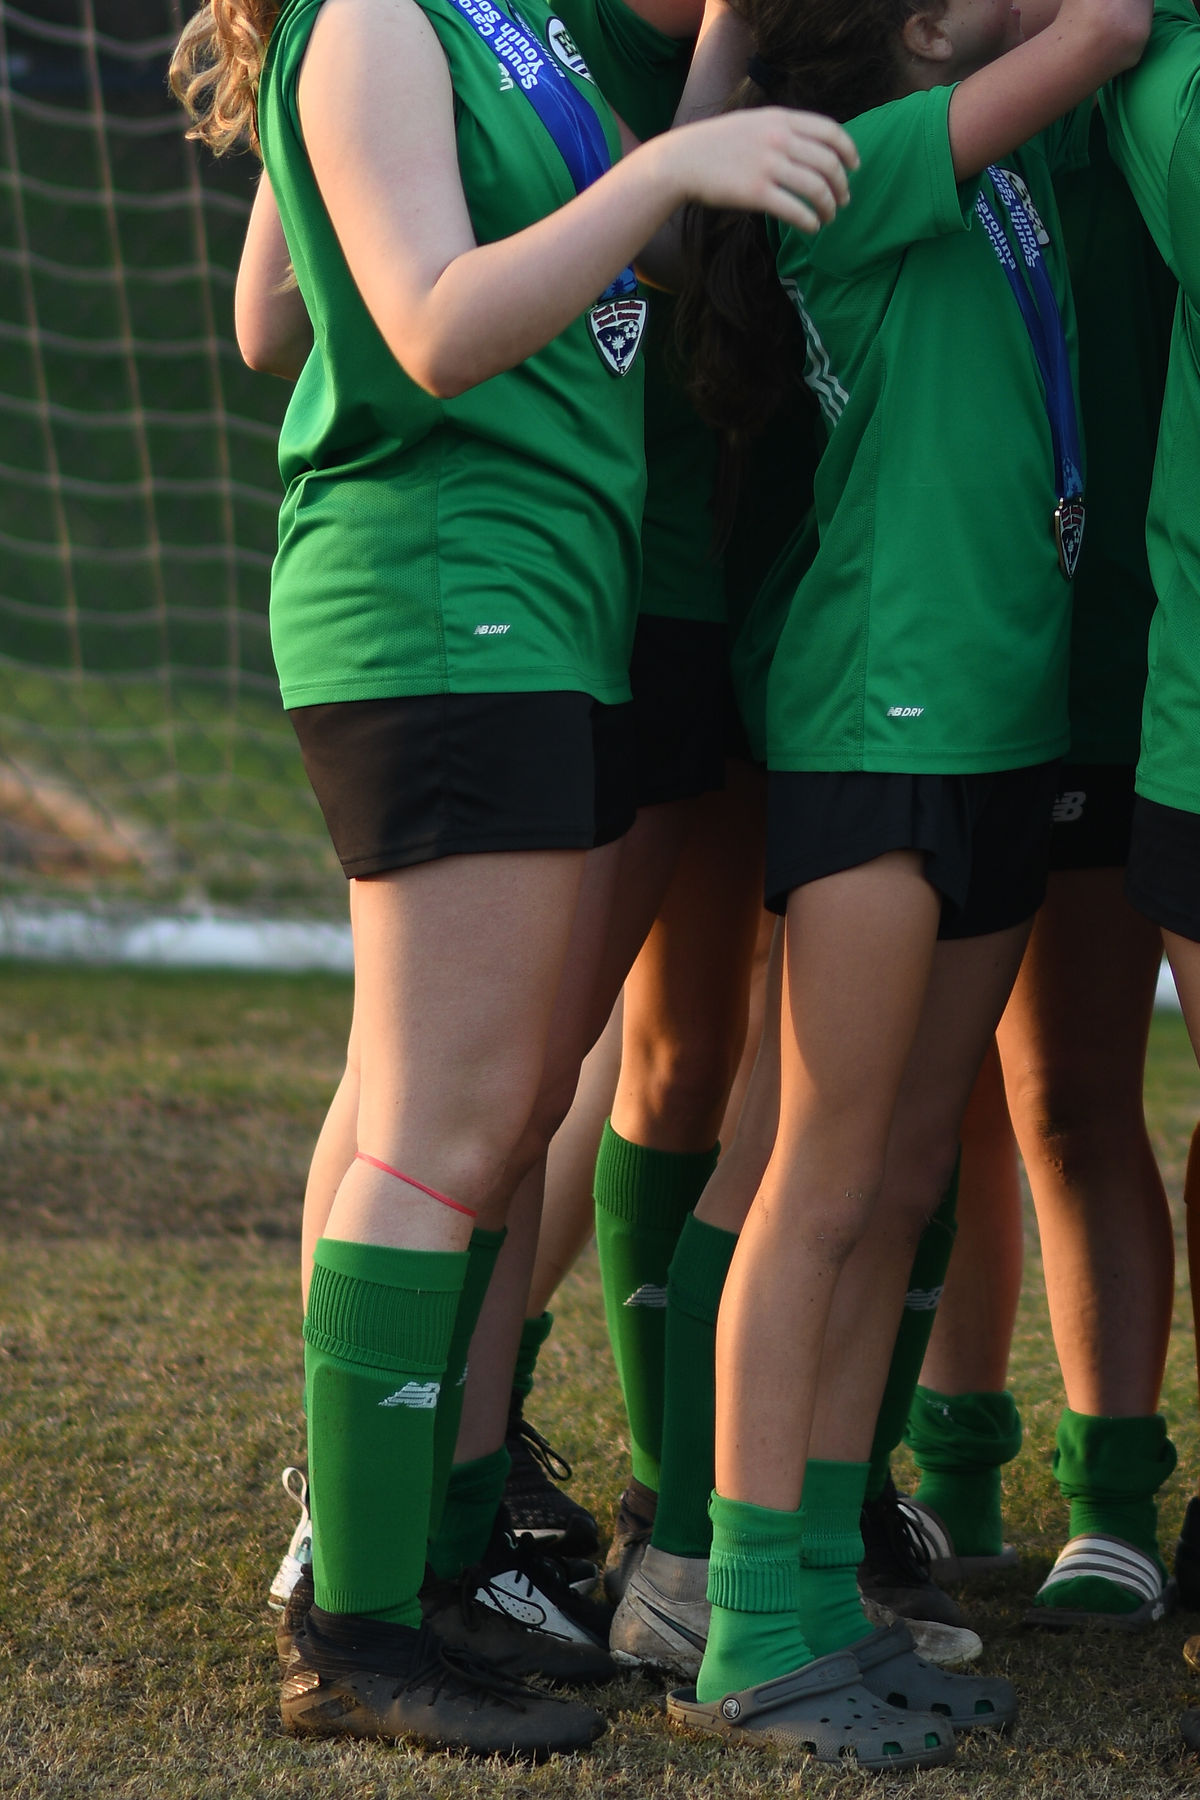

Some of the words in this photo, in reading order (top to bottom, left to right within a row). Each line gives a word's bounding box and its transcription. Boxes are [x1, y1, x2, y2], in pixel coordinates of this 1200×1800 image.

[493, 35, 538, 89] South
[499, 22, 545, 75] Youth
[1010, 210, 1036, 268] South
